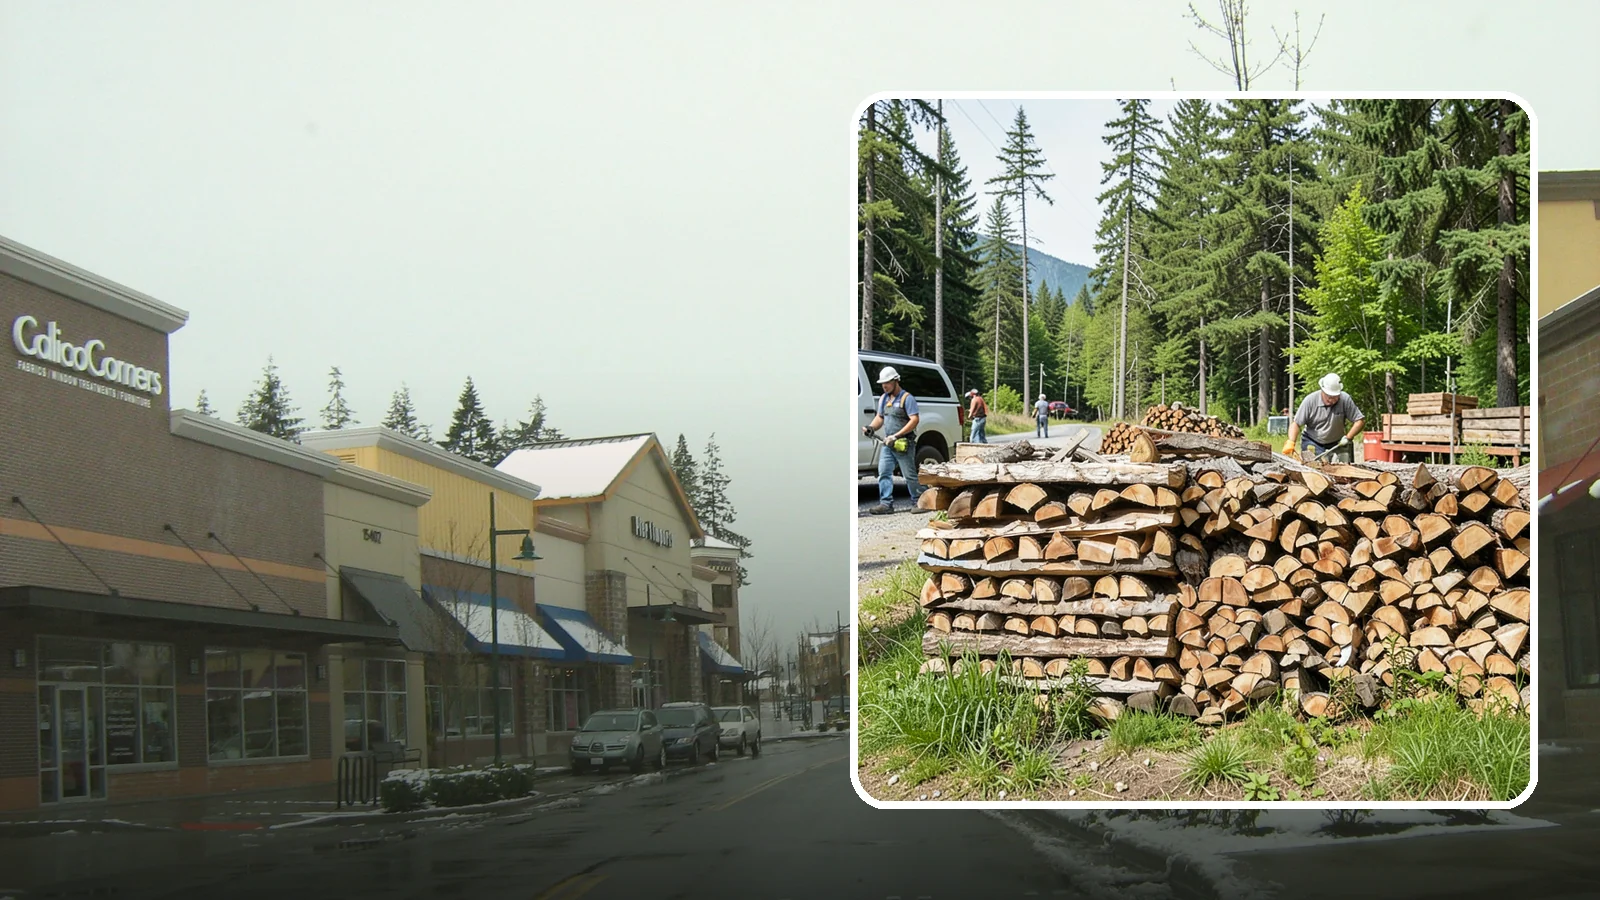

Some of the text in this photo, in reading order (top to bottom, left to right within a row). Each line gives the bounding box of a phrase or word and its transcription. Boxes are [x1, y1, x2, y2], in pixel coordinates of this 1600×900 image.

[17, 359, 151, 409] FABRICS WINDOW TREATMENTS FURNITURE
